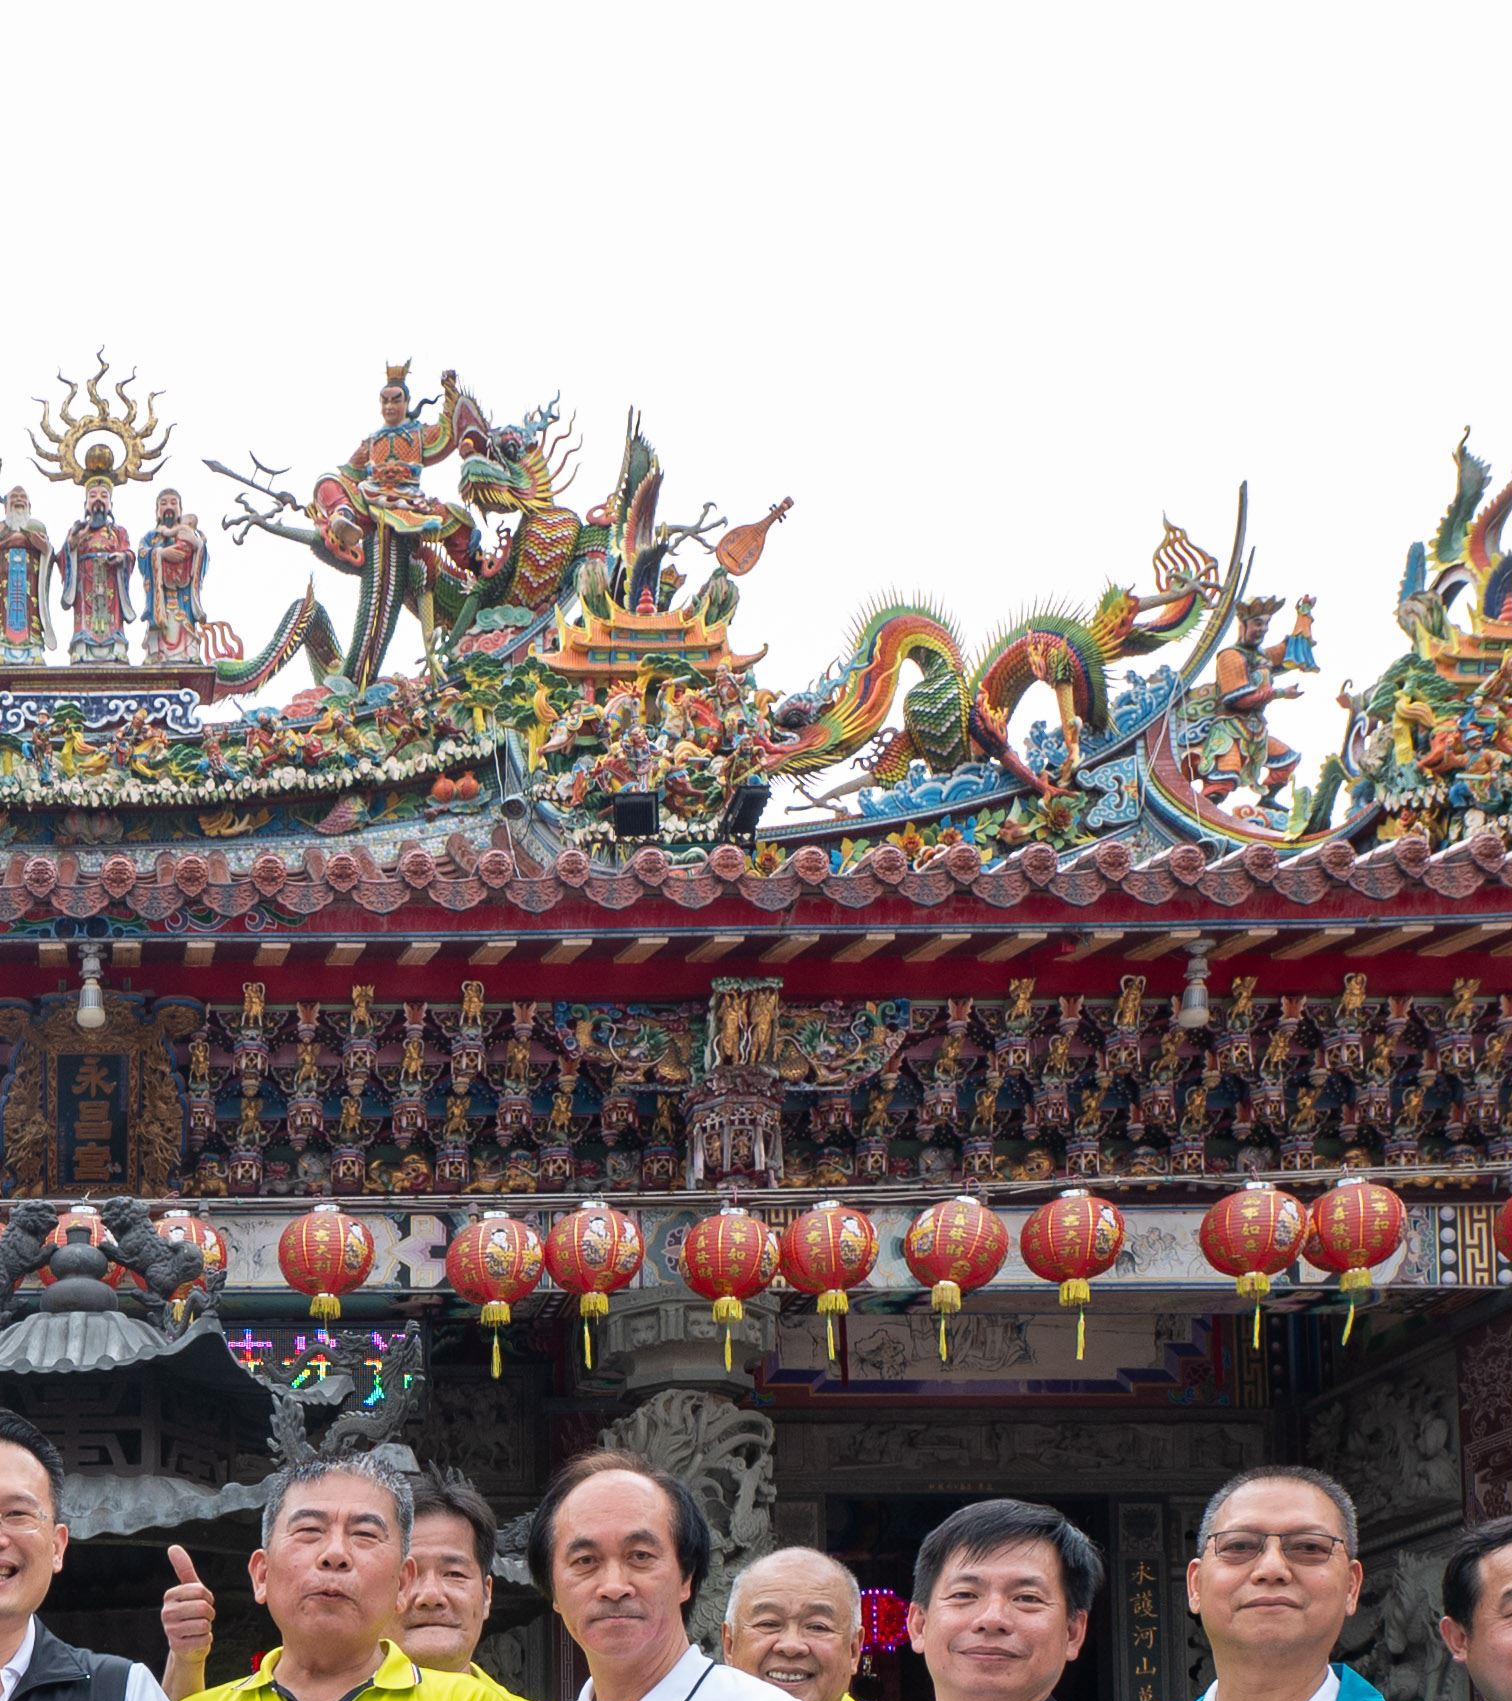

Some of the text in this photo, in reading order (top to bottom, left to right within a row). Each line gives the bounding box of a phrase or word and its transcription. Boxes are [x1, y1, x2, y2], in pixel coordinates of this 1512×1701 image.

[71, 1056, 117, 1181] 永昌宮
[311, 1217, 334, 1274] 大吉大利
[693, 1220, 715, 1280] 恭喜發財
[725, 1217, 749, 1278] 萬事如意
[803, 1216, 830, 1276] 大吉大利
[945, 1203, 969, 1259] 恭喜發財
[1060, 1200, 1083, 1258] 大吉大利
